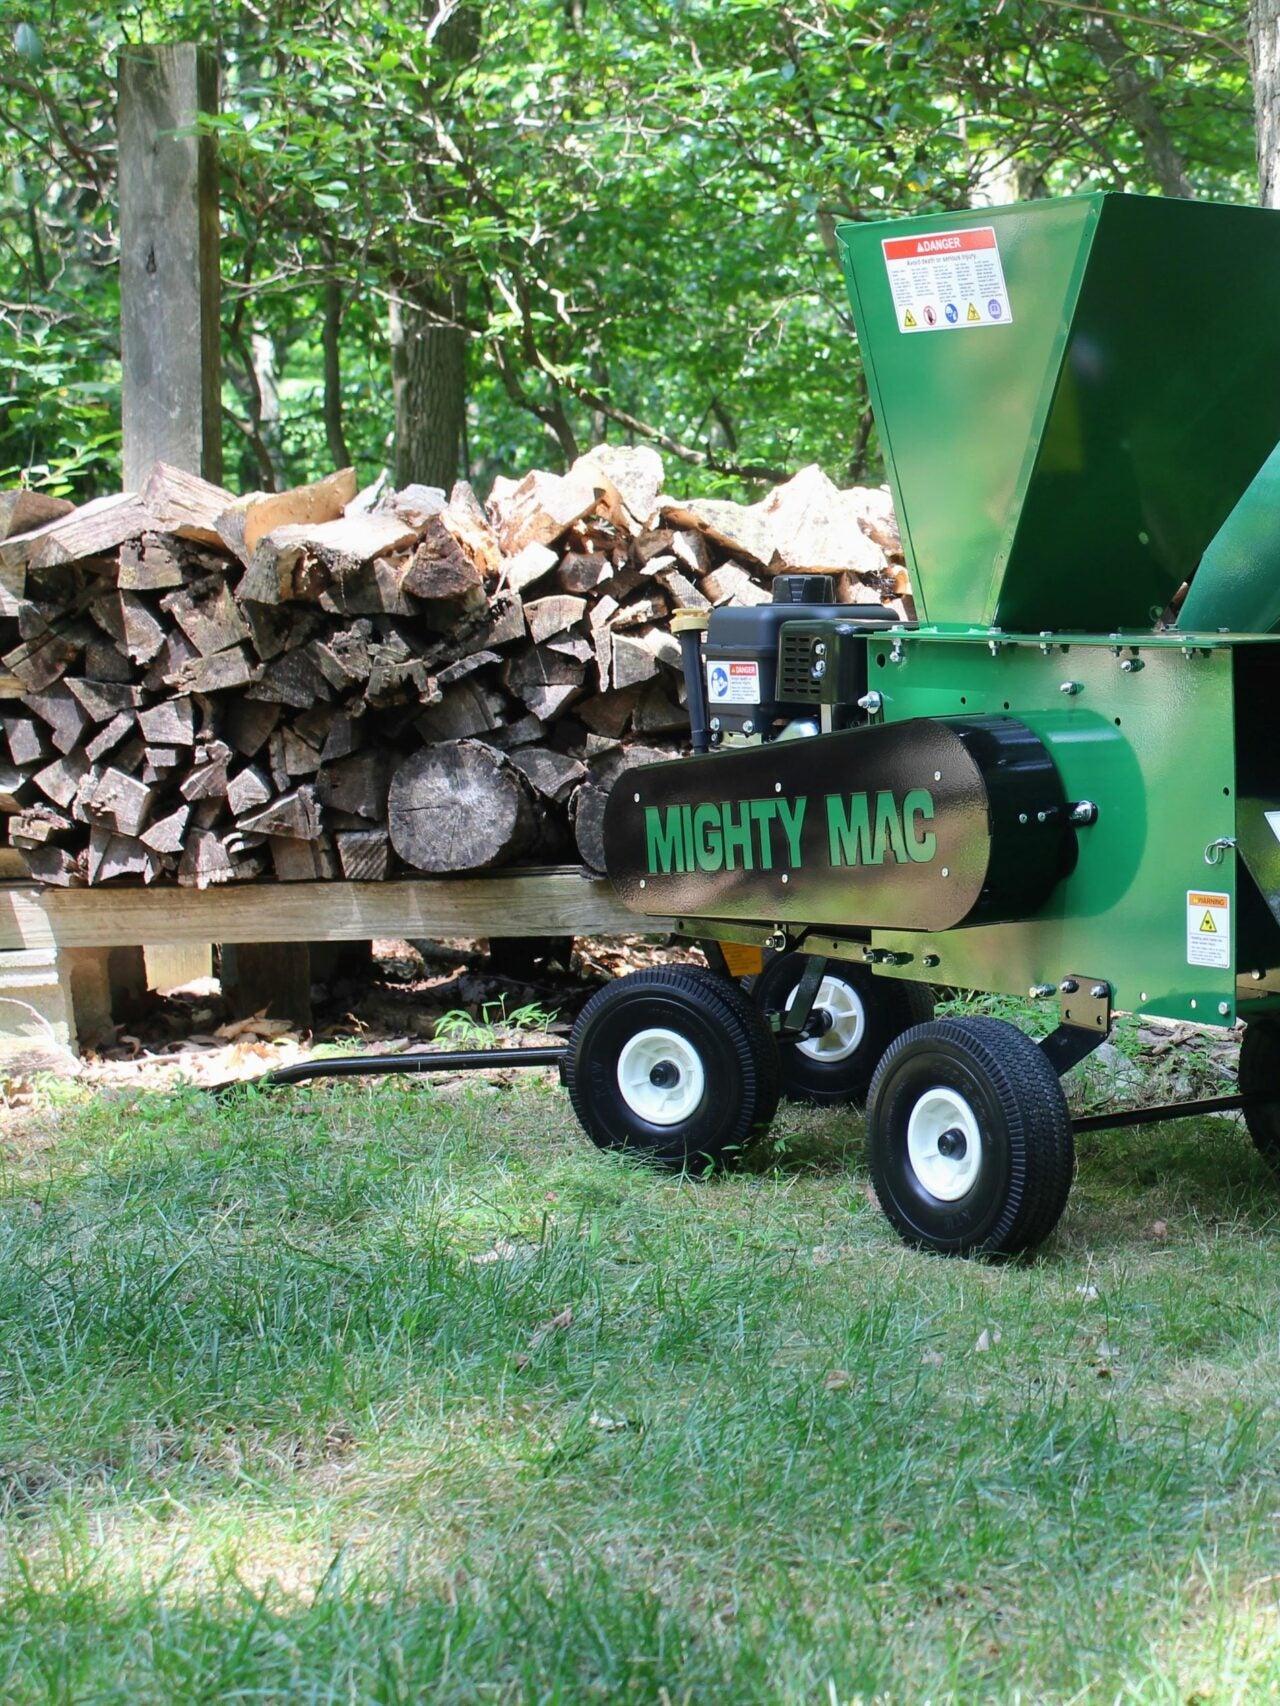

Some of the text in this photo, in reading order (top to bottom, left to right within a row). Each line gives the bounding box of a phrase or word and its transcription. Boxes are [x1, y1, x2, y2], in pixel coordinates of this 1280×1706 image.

[922, 237, 961, 252] DANGER
[644, 788, 937, 874] MIGHTY MAC
[1199, 898, 1225, 906] WARNING
